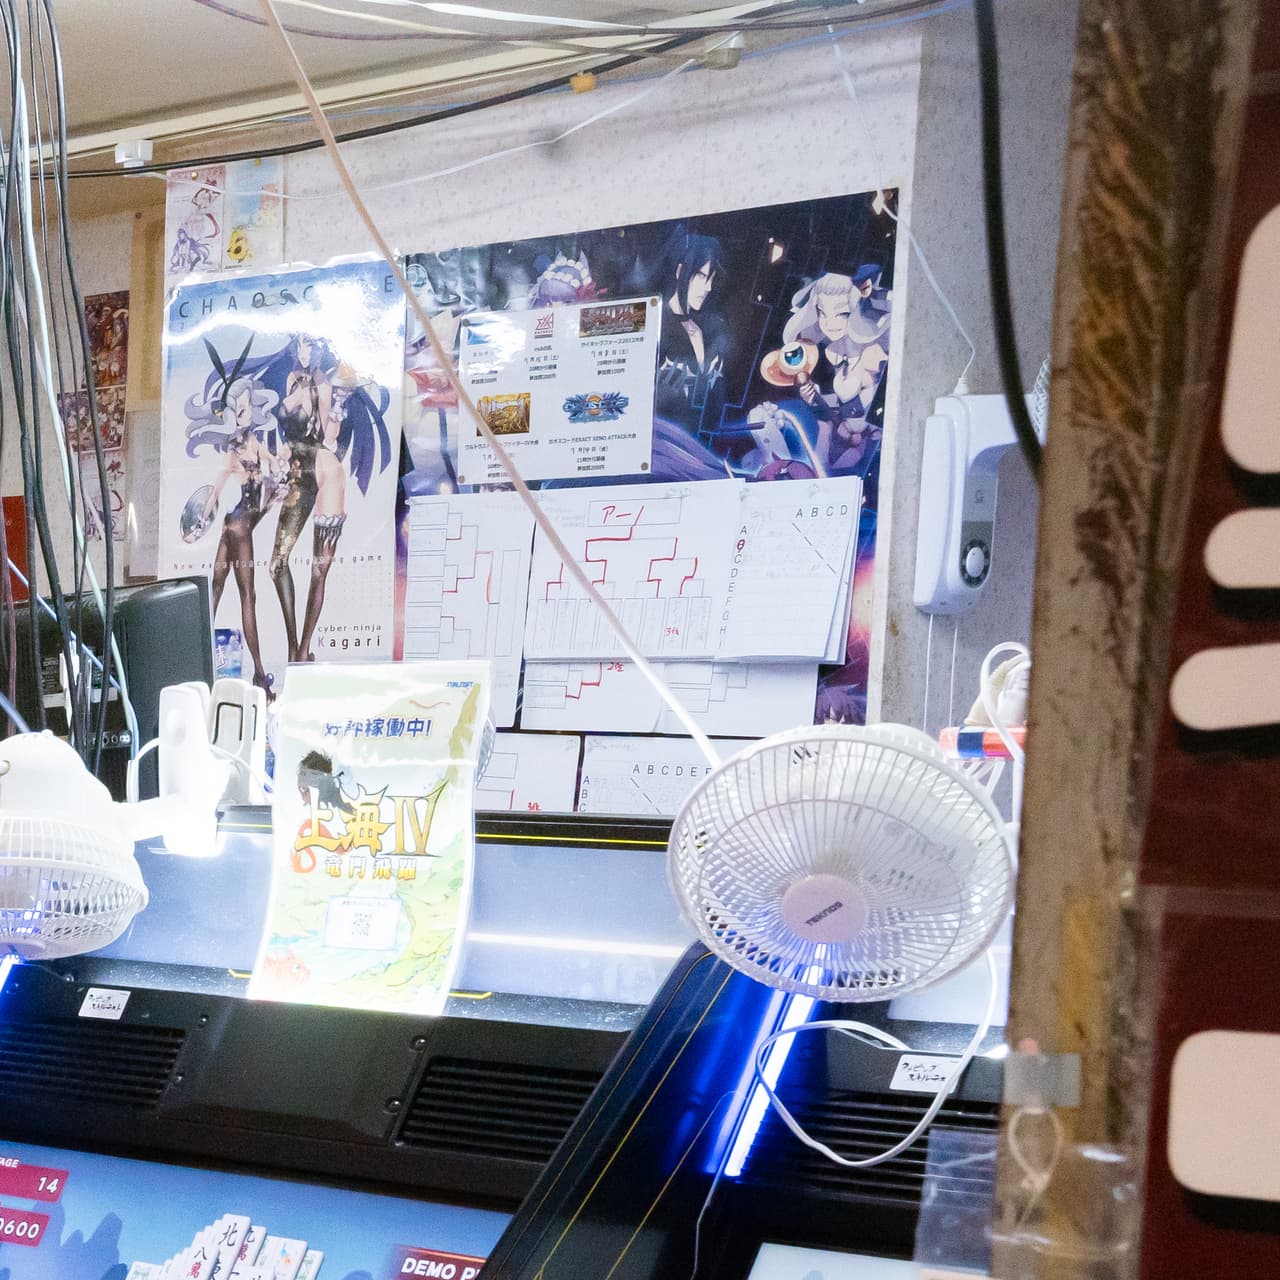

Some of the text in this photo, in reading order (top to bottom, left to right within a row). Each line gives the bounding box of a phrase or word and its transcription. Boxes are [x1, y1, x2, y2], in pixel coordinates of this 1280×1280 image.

[179, 275, 394, 318] CHAOSCE
[318, 624, 382, 633] cyber-ninja
[318, 635, 381, 649] Kagari
[37, 1177, 59, 1192] 14
[401, 1257, 456, 1280] DEMO
